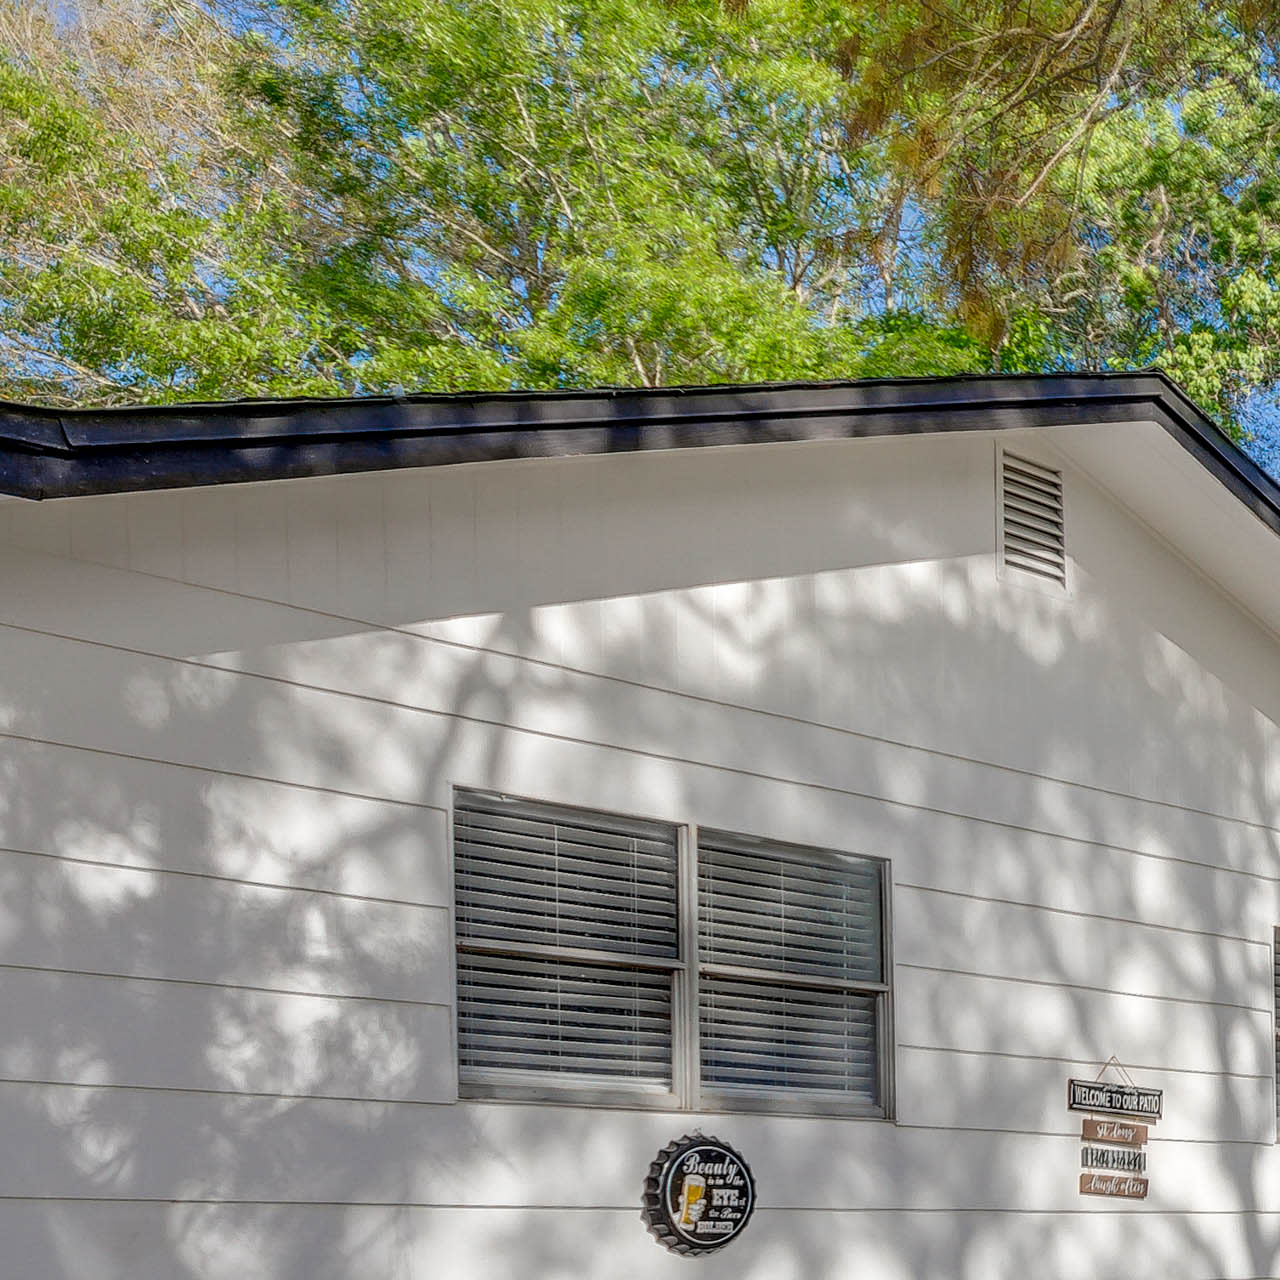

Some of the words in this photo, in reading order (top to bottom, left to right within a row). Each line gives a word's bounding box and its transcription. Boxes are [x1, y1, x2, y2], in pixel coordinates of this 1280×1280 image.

[1075, 1085, 1111, 1107] WELCOME
[1112, 1094, 1122, 1107] TO
[1123, 1095, 1138, 1110] OUR
[1139, 1095, 1159, 1113] PATIO
[1111, 1123, 1136, 1141] long
[683, 1153, 738, 1184] Beauty
[1087, 1175, 1119, 1193] laugh
[1120, 1178, 1145, 1195] often
[712, 1189, 739, 1206] EYE
